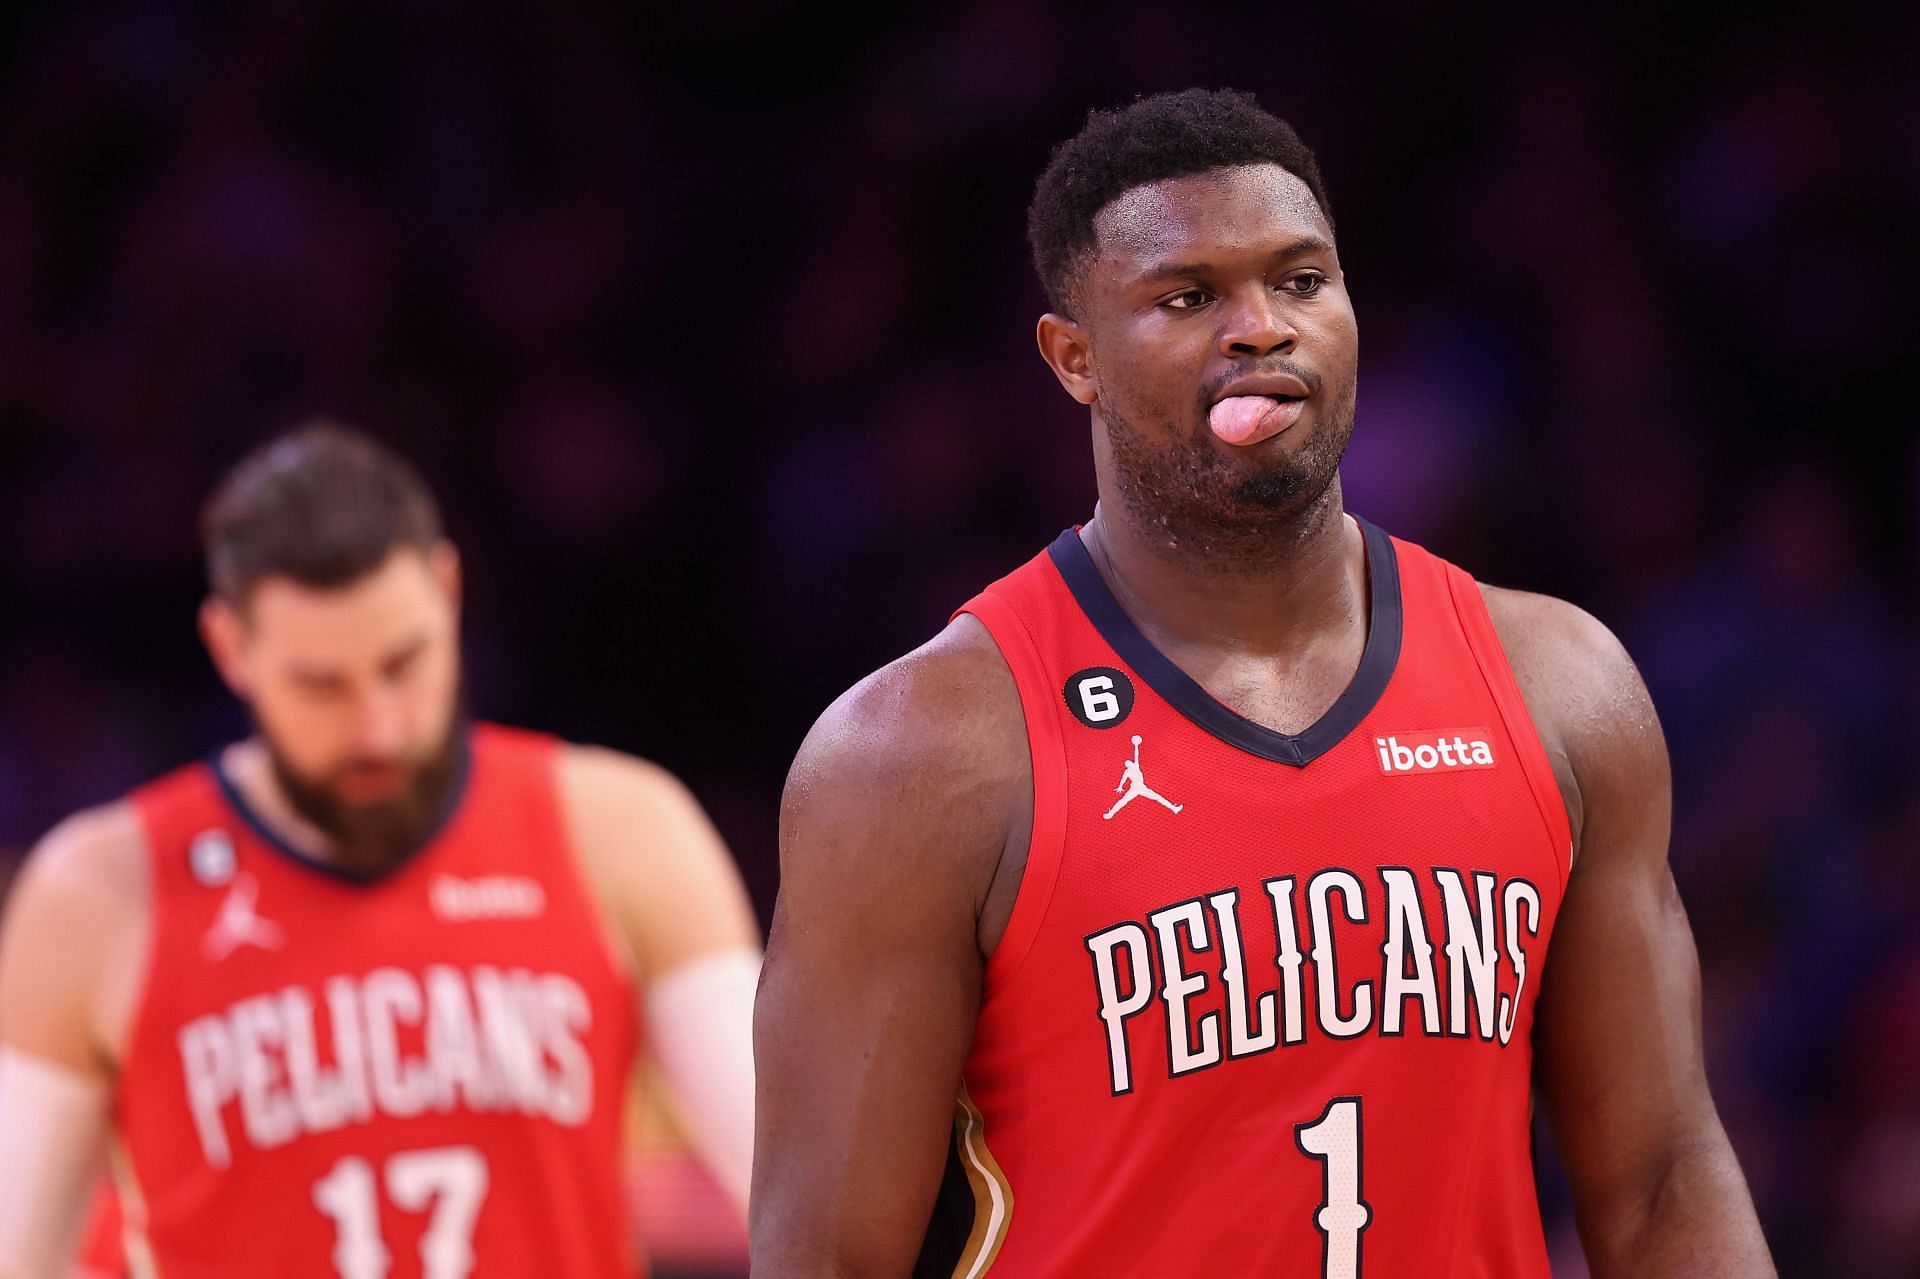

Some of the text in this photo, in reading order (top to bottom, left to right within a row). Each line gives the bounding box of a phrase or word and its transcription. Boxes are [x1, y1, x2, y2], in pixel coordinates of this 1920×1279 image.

[1078, 675, 1120, 722] 6
[1377, 736, 1495, 772] ibotta
[1085, 866, 1541, 1096] PELICANS
[180, 963, 594, 1168] PELICANS
[312, 1144, 488, 1279] 17
[1295, 1096, 1372, 1279] 1
